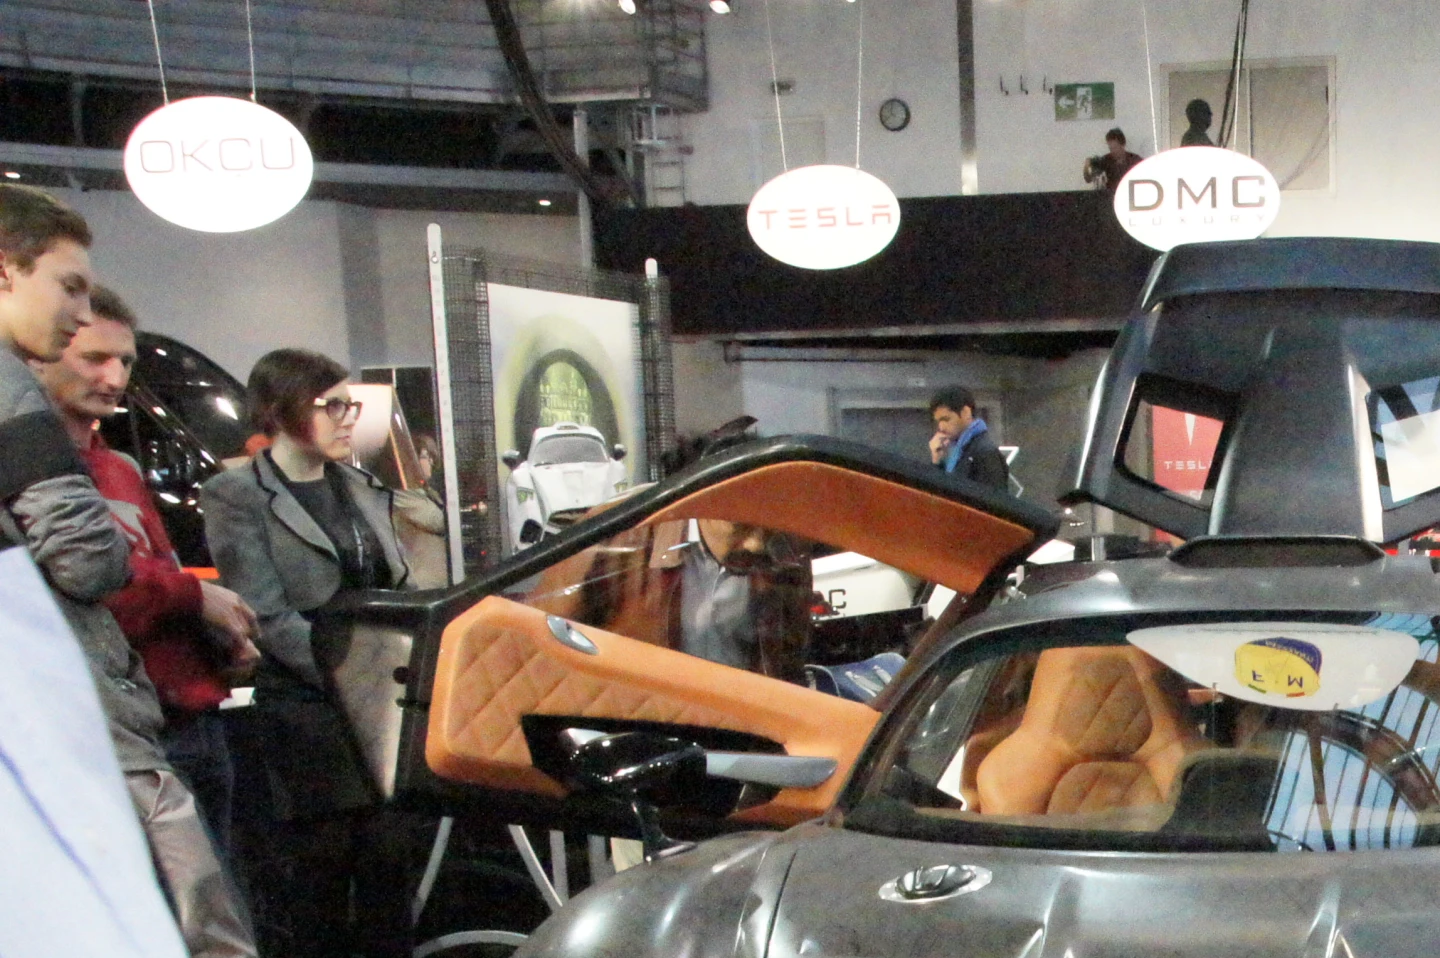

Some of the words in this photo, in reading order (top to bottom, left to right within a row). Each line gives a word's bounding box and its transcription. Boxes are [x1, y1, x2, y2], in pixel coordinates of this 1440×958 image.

[1127, 174, 1266, 212] DMC
[757, 204, 892, 231] TESLA
[1163, 459, 1211, 471] TESL
